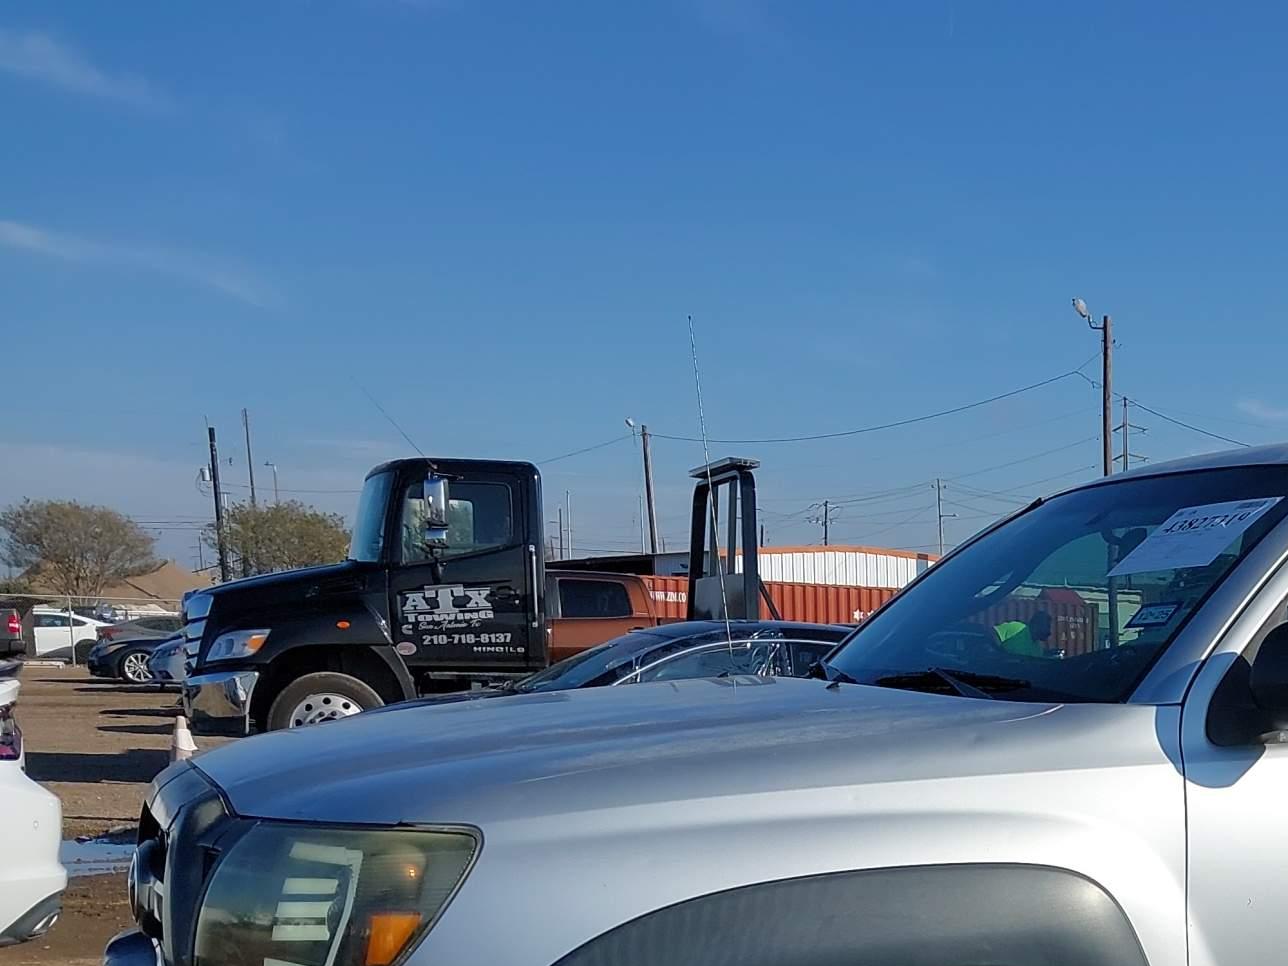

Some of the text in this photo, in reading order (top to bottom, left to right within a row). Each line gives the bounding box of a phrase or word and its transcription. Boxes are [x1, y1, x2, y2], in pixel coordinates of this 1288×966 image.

[402, 584, 491, 613] ATX
[404, 610, 494, 622] TOWING
[422, 632, 512, 645] 210-718-8137
